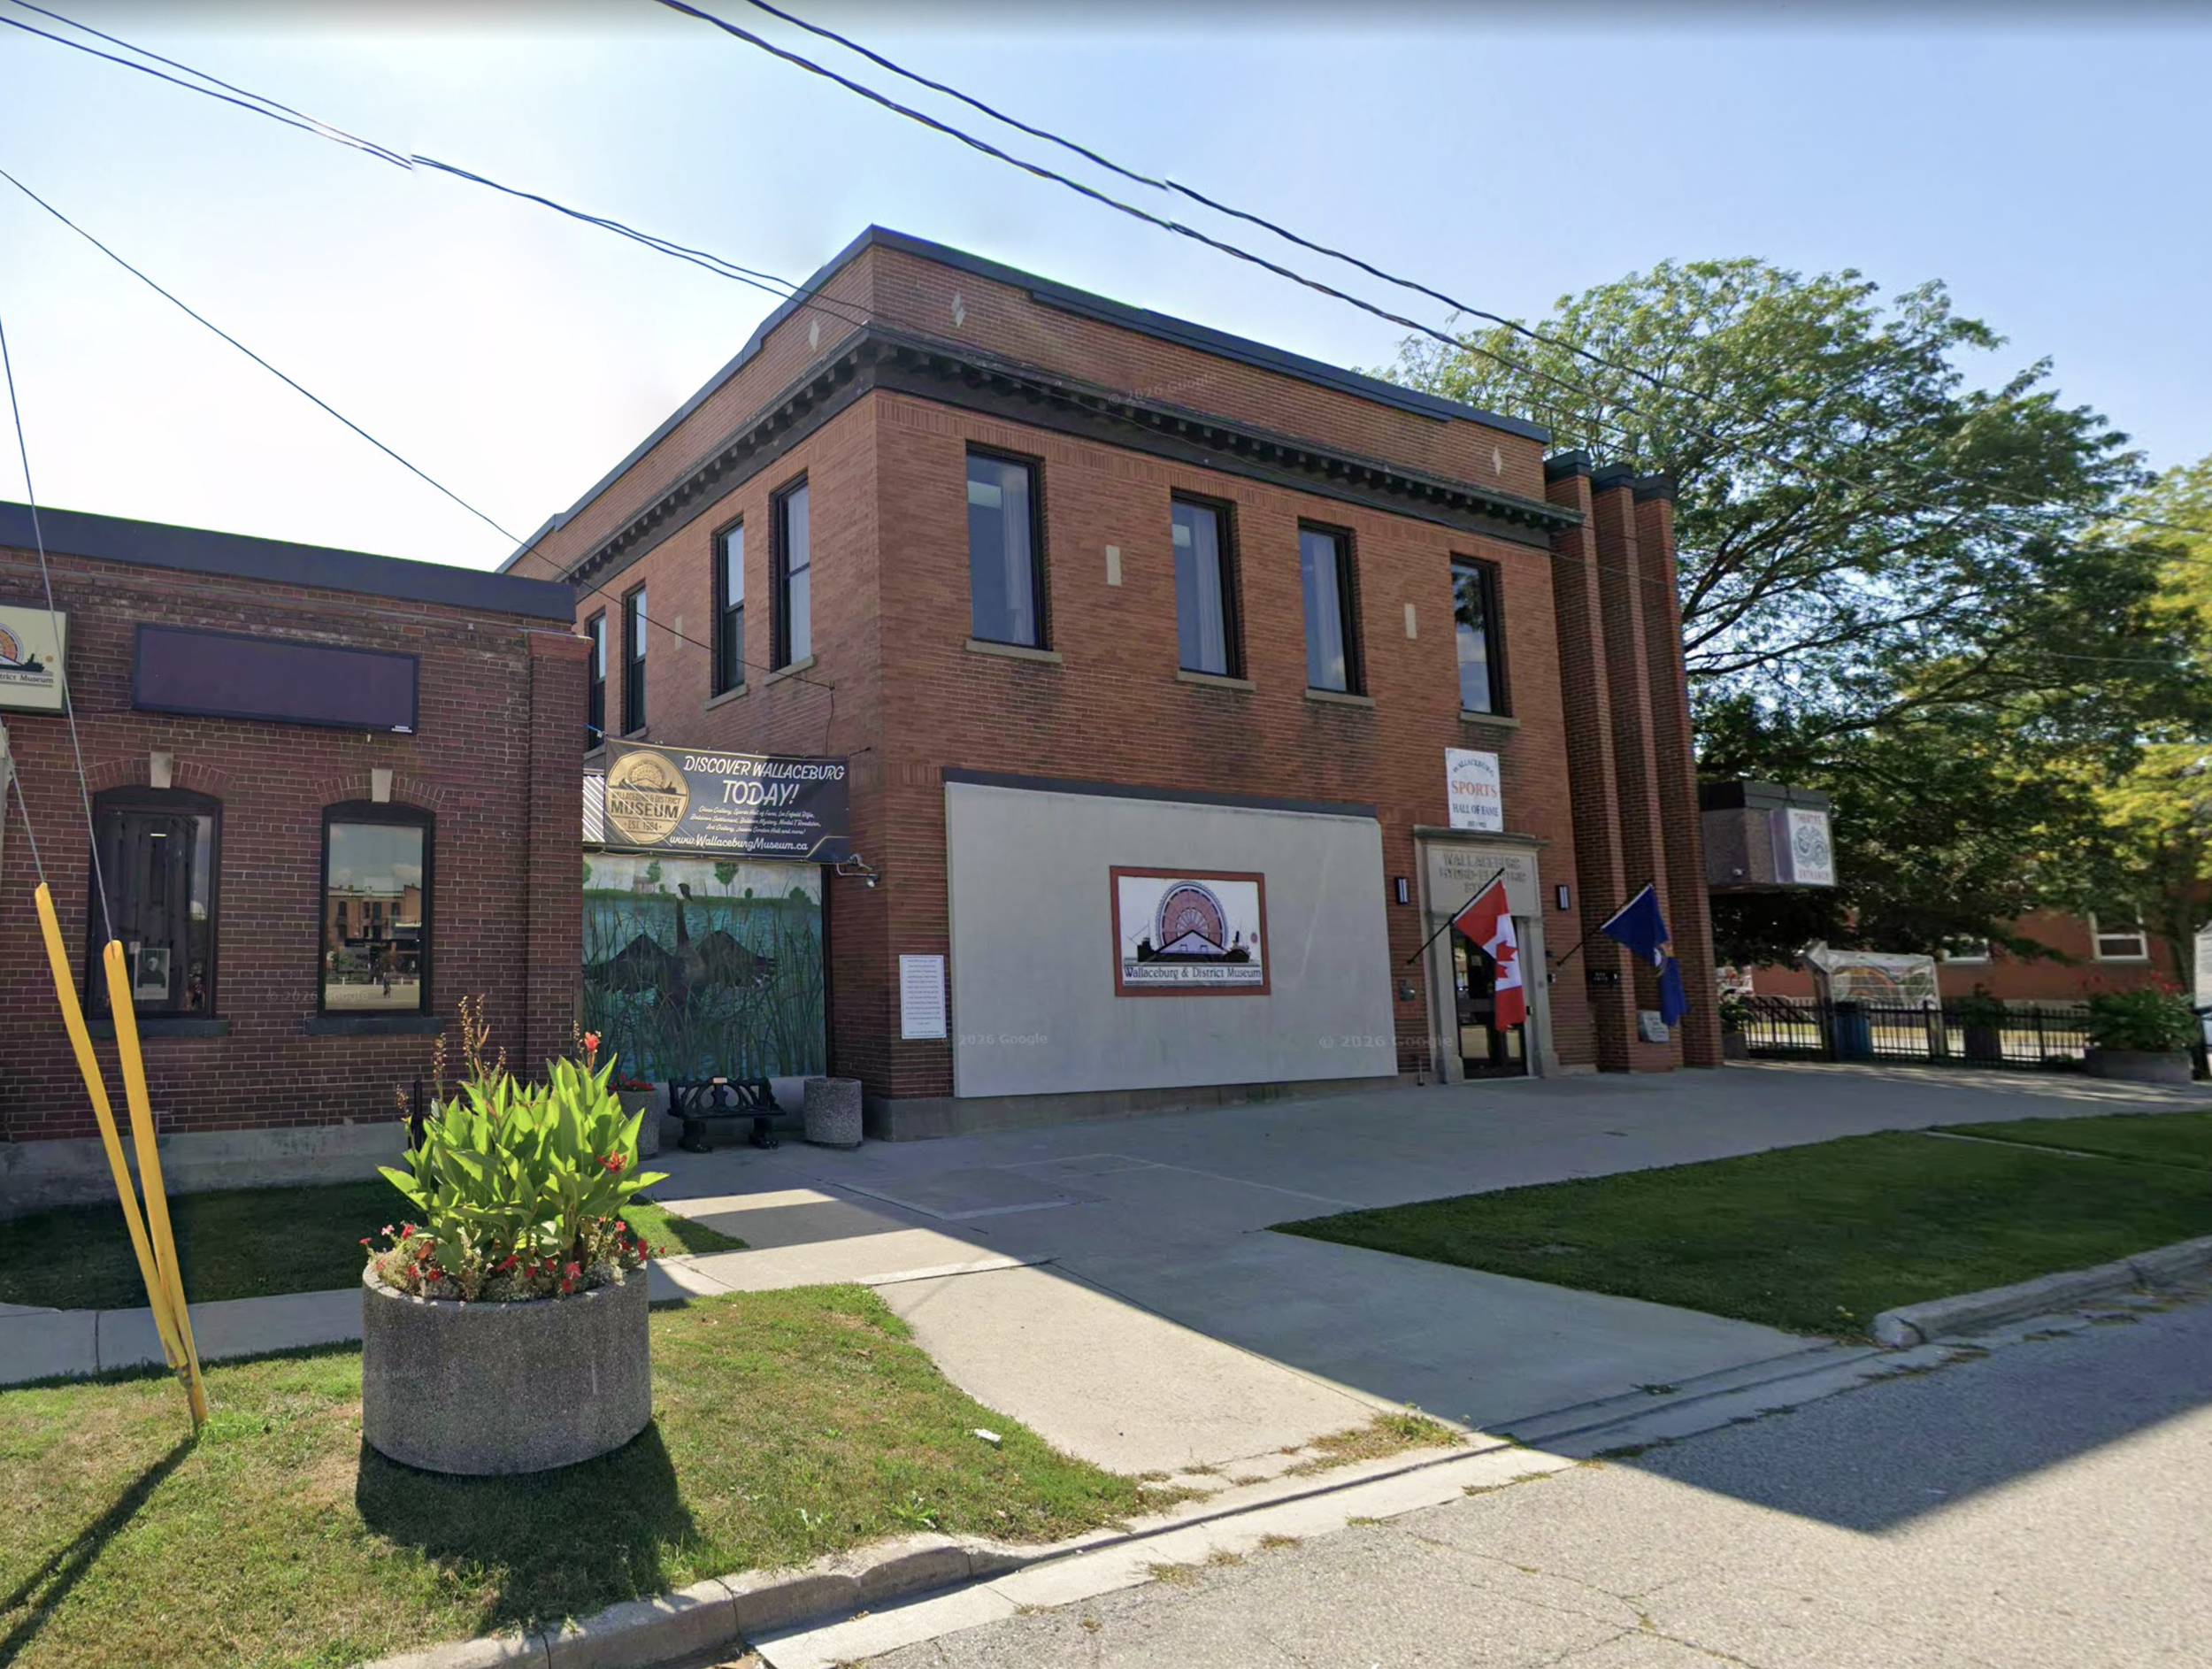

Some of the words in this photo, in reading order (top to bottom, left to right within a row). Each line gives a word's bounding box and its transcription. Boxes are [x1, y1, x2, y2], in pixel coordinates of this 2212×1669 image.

[20, 674, 54, 684] Museum
[684, 756, 751, 777] DISCOVER
[752, 762, 845, 781] WALLACEBURG
[722, 780, 800, 807] TODAY!
[1452, 781, 1498, 797] SPORTS
[655, 796, 681, 805] DISTRICT
[611, 799, 680, 819] MUSEUM
[1453, 803, 1470, 814] HALL
[1471, 804, 1480, 815] OF
[1481, 805, 1499, 817] FAME
[670, 833, 809, 852] www.WallaceburgMuseum.ca
[1125, 966, 1179, 981] Wallaceburg
[1182, 967, 1189, 978] &
[1193, 967, 1224, 978] District
[1227, 968, 1262, 978] Museum
